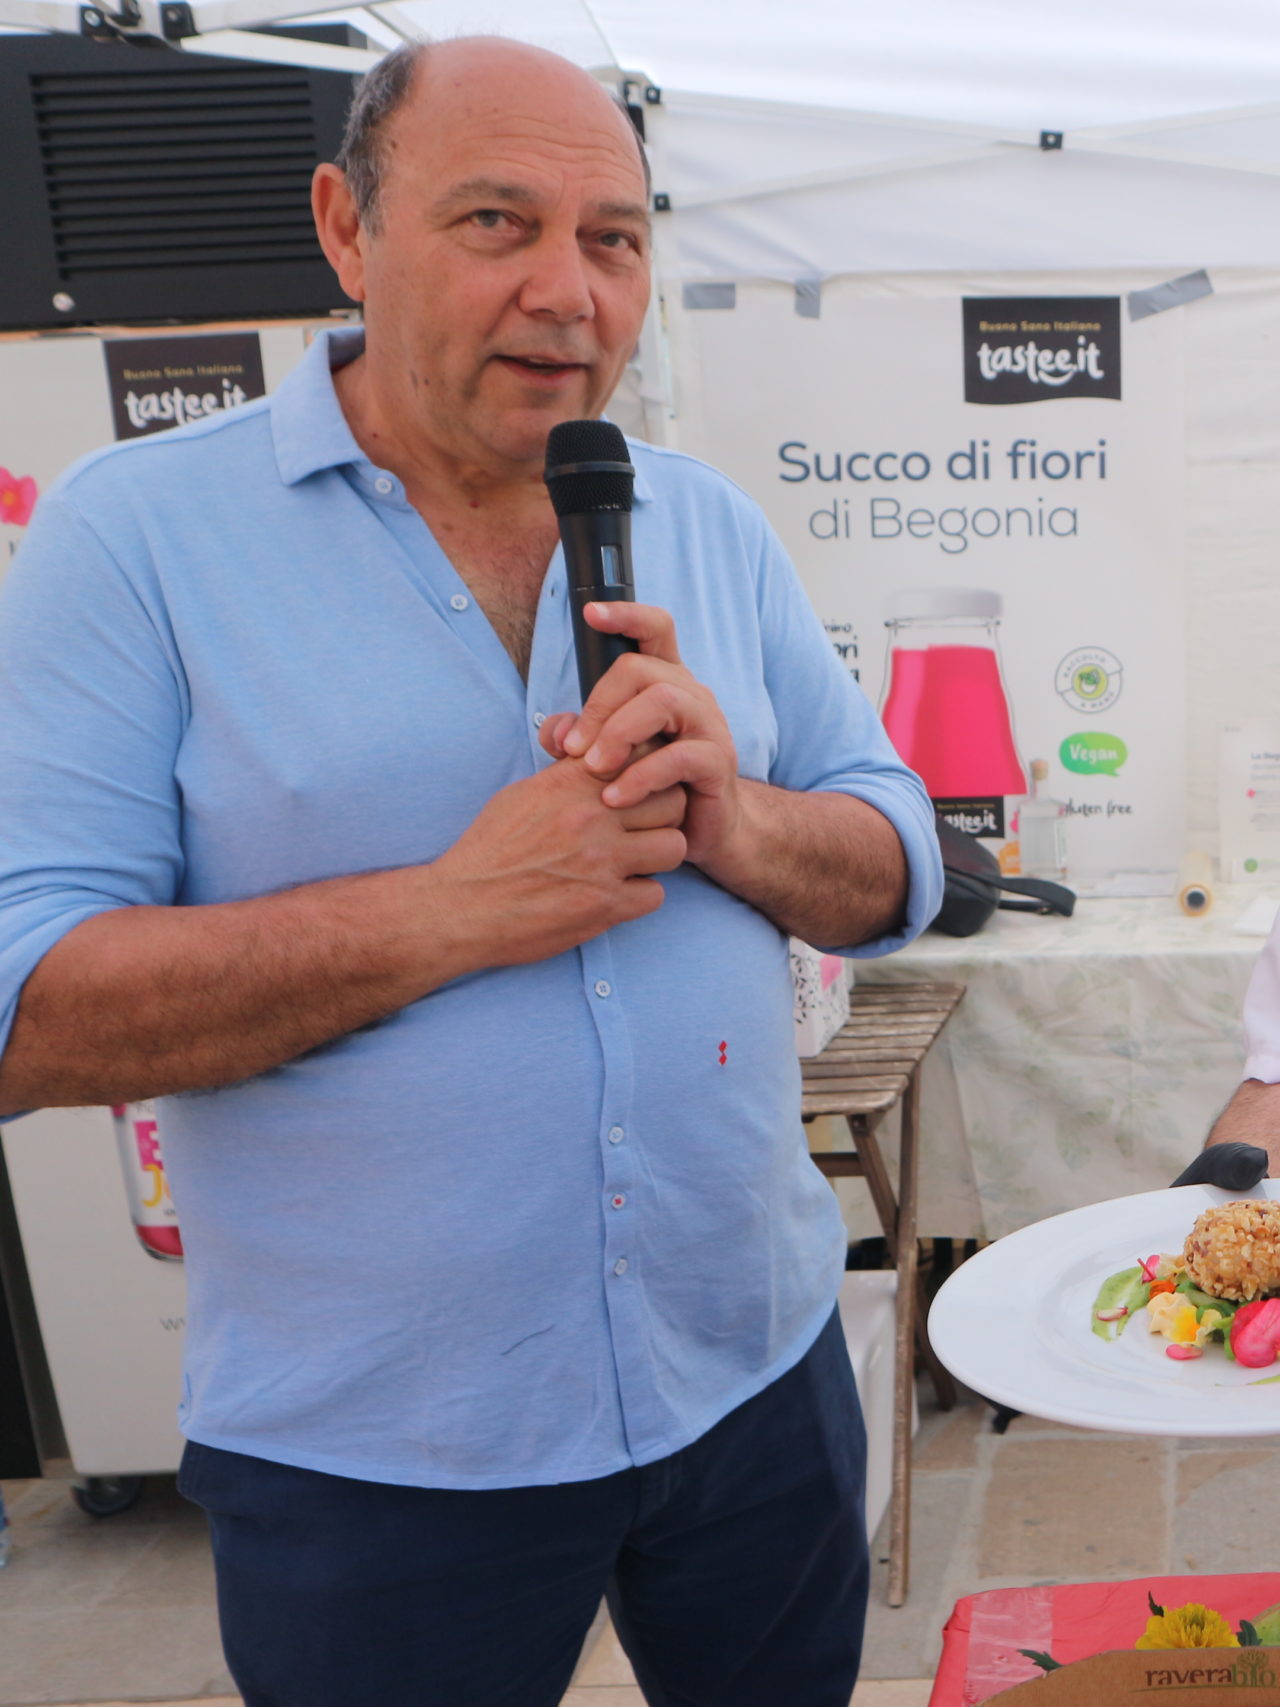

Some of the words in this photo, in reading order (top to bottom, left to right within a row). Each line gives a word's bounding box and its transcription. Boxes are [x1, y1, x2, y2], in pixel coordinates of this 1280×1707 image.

[977, 335, 1105, 386] tastee.it
[778, 441, 931, 483] Succo
[947, 439, 991, 482] di
[1006, 439, 1107, 481] fiori
[809, 498, 850, 540] di
[870, 497, 1079, 555] Begonia
[1069, 744, 1119, 765] Vegan
[1107, 800, 1133, 818] free
[1144, 1658, 1277, 1688] raverabio
